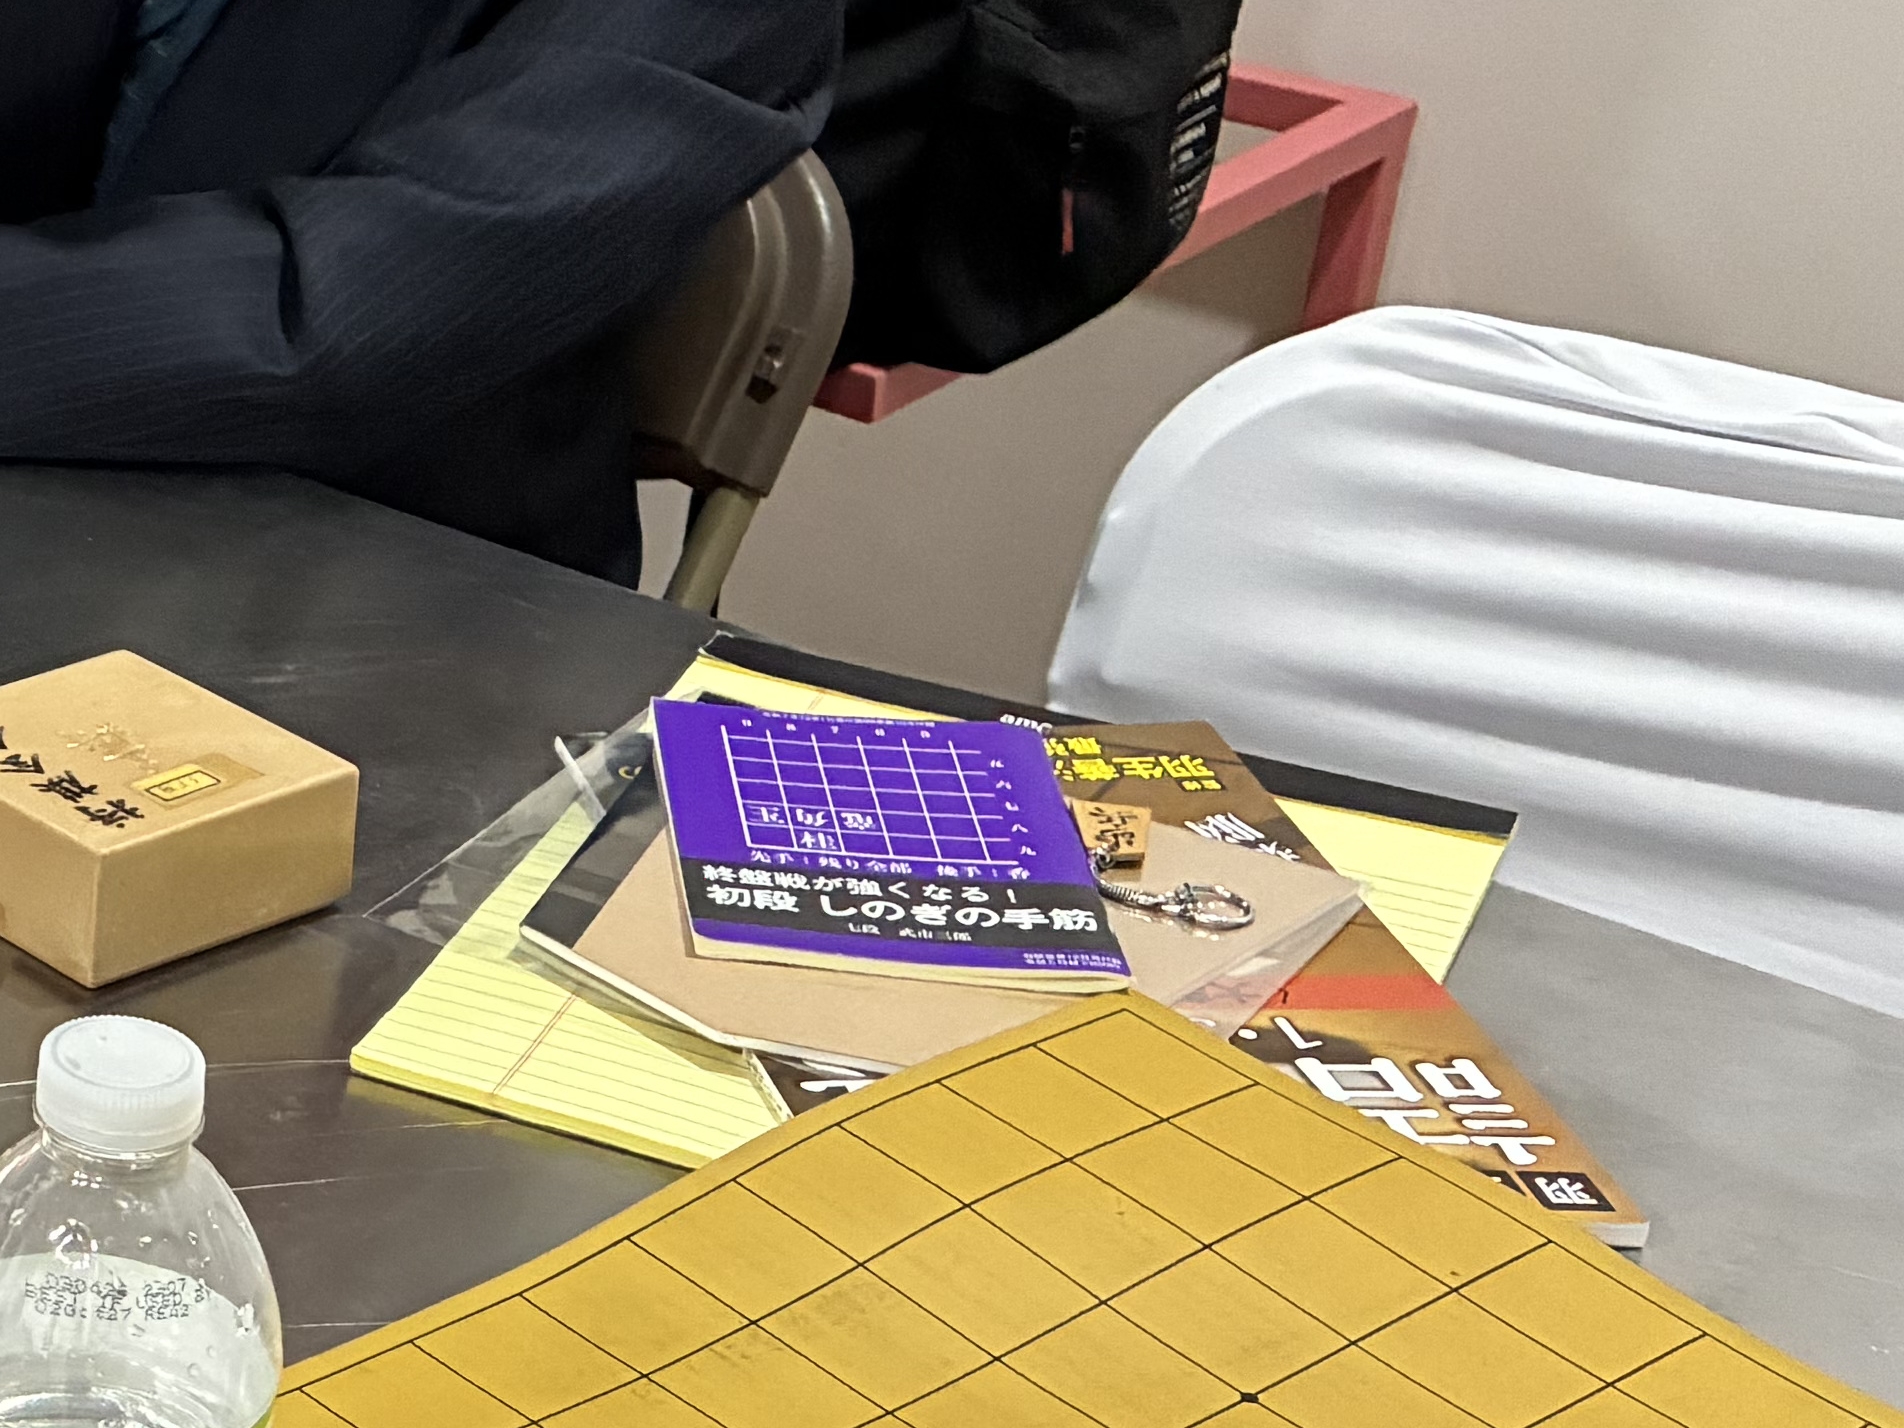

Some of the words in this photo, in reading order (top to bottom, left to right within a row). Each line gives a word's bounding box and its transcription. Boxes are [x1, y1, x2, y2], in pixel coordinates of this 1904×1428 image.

[707, 884, 799, 913] 初段
[820, 895, 1097, 931] しのぎの手筋
